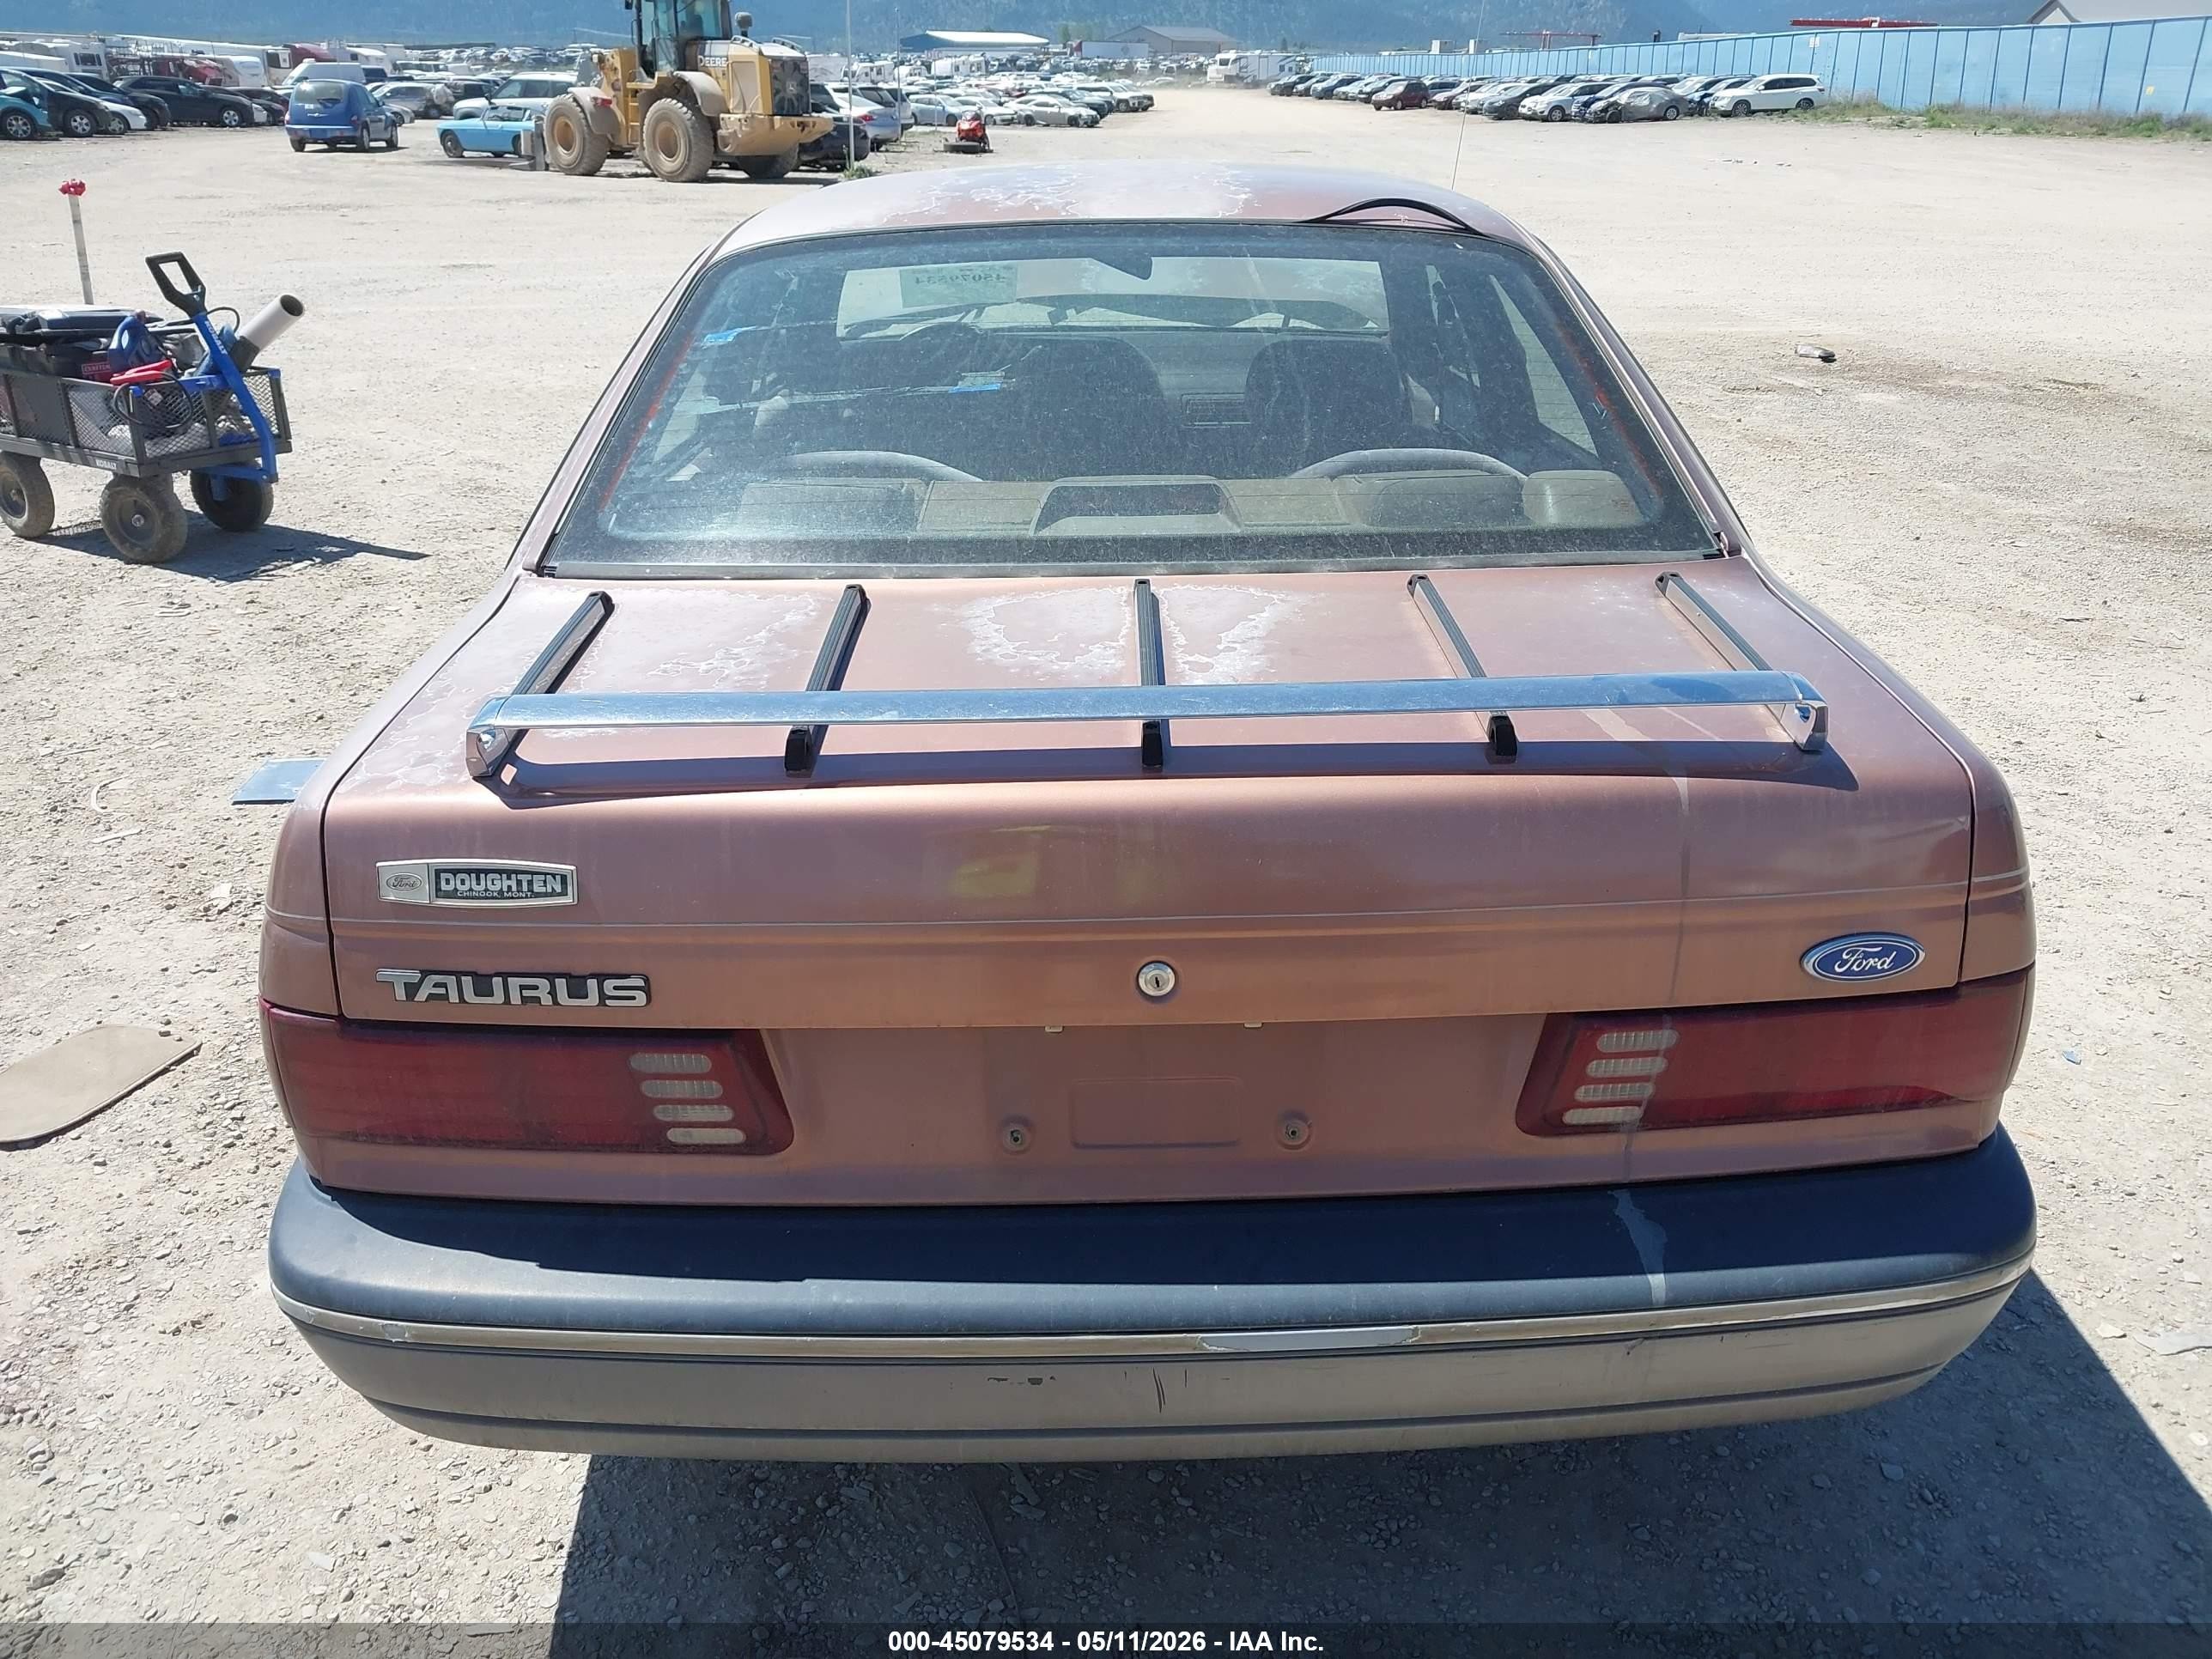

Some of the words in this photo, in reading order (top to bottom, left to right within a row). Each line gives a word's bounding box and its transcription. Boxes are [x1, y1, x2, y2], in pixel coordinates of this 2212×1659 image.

[698, 55, 728, 67] DEERE
[204, 320, 228, 355] KOBALT
[392, 877, 416, 888] Ford
[440, 872, 562, 893] DOUGHTEN
[1834, 946, 1897, 973] Ford
[376, 969, 649, 1007] TAURUS
